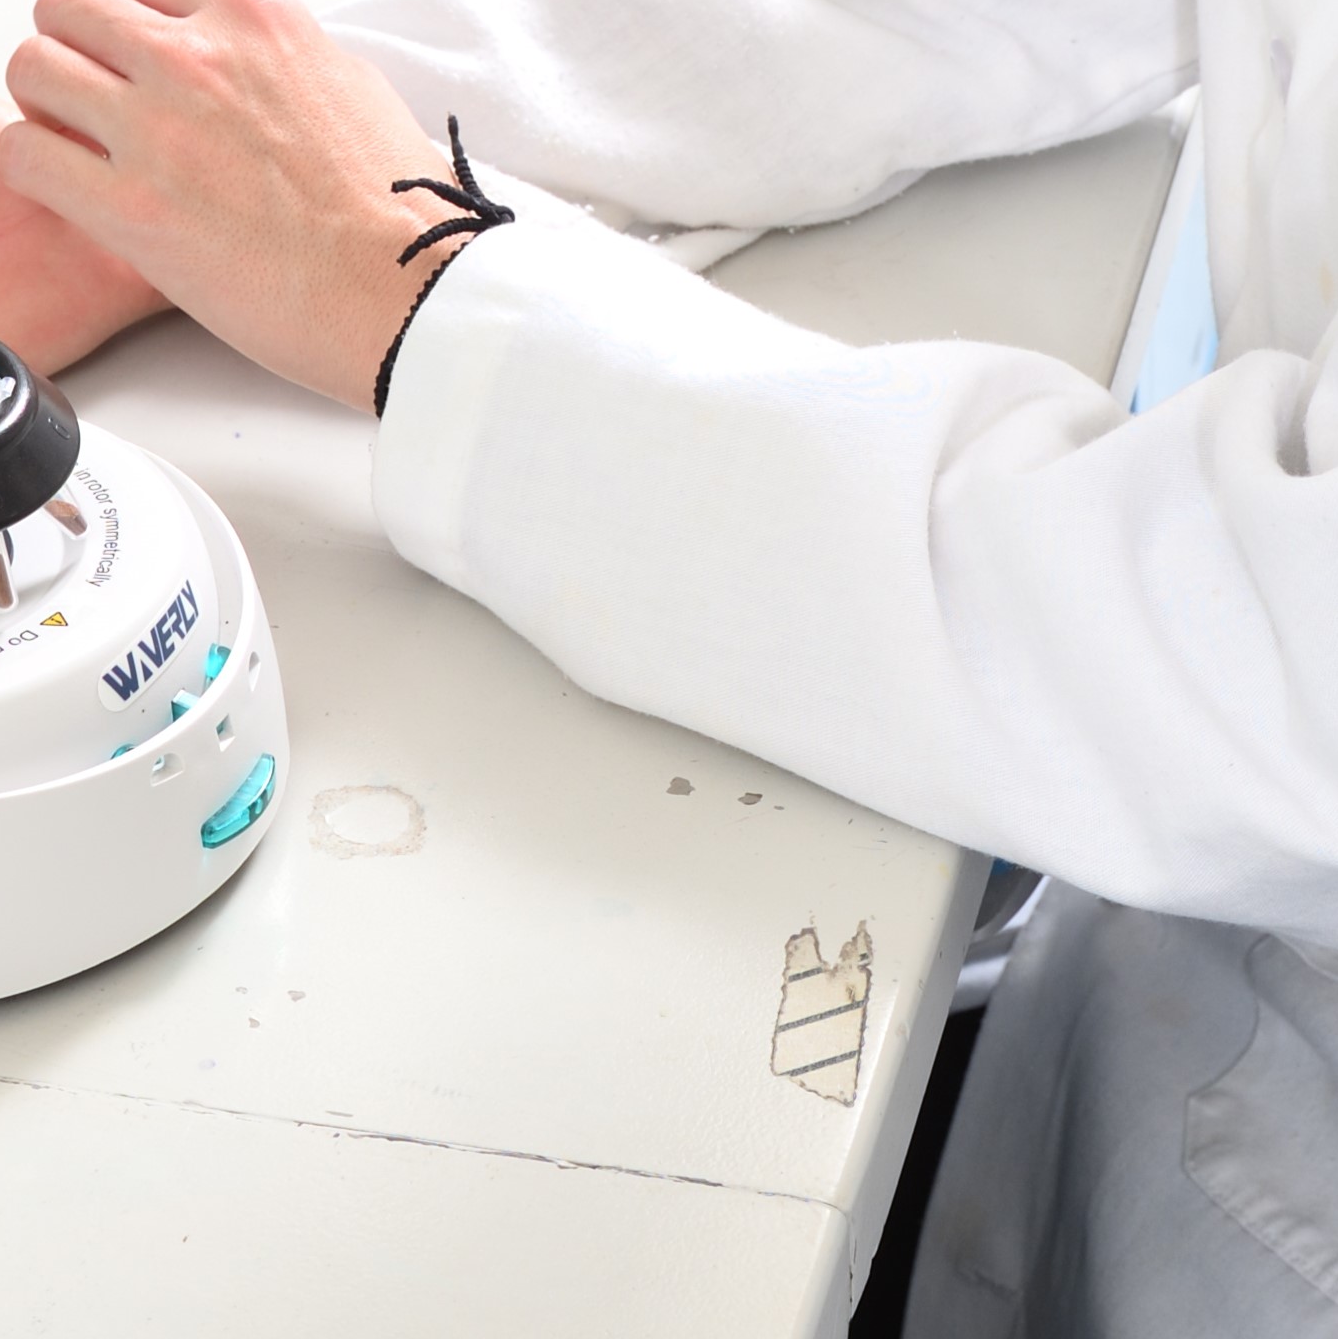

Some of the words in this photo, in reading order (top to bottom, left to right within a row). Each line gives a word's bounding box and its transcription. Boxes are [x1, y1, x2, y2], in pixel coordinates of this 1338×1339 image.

[83, 478, 113, 504] rotor
[85, 507, 121, 588] symmetrically
[8, 628, 39, 646] Do
[102, 579, 200, 702] WAVERLY
